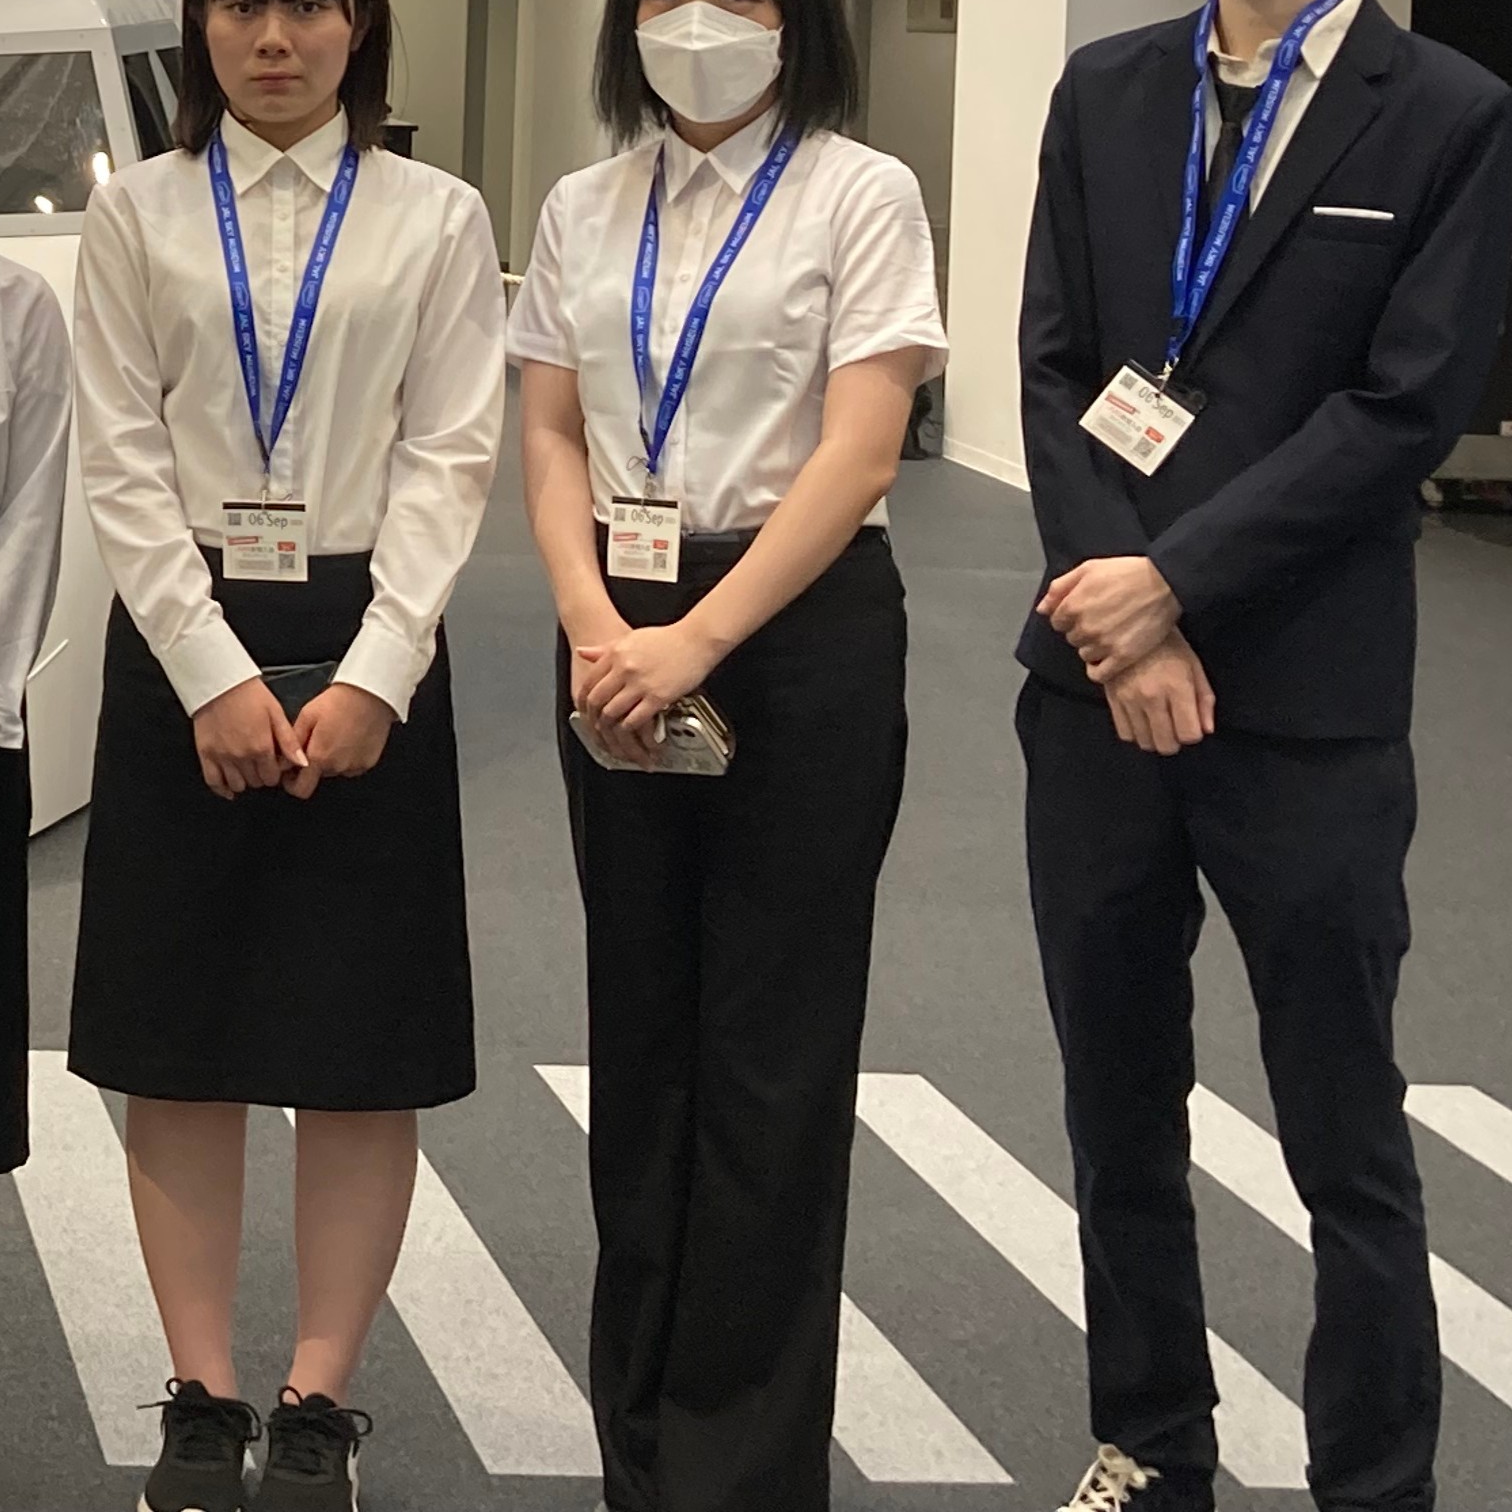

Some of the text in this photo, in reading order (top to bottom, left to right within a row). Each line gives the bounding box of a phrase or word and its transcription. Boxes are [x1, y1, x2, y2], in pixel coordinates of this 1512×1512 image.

[1247, 79, 1281, 163] JAL SKY MUSEUM
[767, 146, 788, 179] JAL SKY
[222, 207, 241, 273] JAL SKY MUSEUM
[311, 211, 339, 279] JAL SKY MUSEUM
[713, 212, 754, 280] JAL SKY MUSEUM
[1197, 203, 1236, 287] JAL SKY MUSEUM
[238, 311, 257, 397] JAL SKY MUSEUM
[636, 315, 645, 330] JAL
[282, 317, 307, 400] JAL SKY MUSEUM
[670, 317, 700, 399] JAL SKY MUSEUM
[265, 513, 288, 530] Sep
